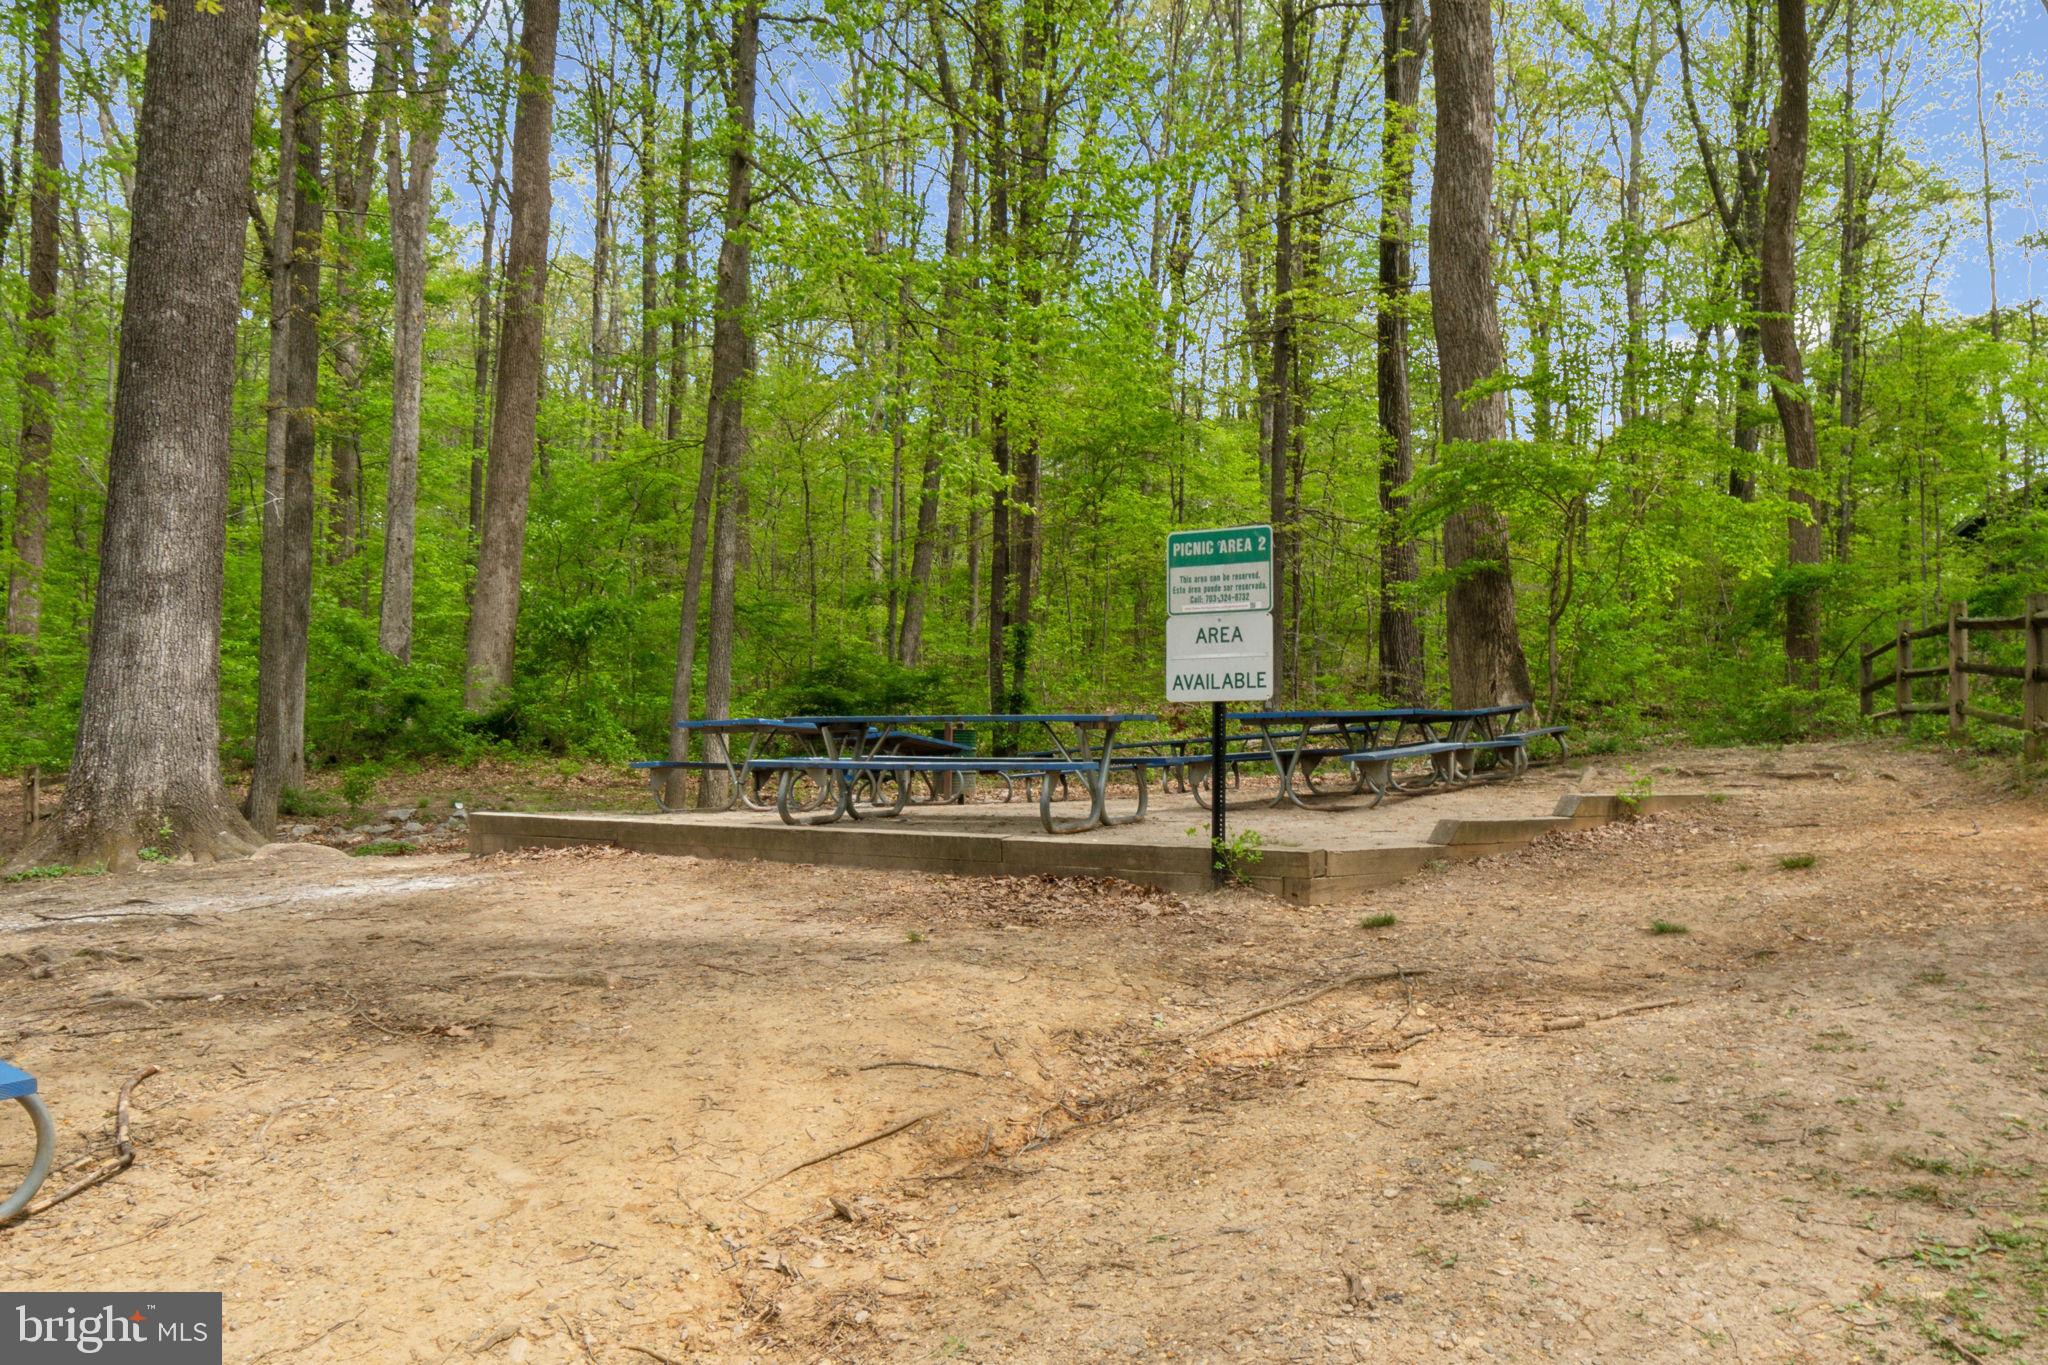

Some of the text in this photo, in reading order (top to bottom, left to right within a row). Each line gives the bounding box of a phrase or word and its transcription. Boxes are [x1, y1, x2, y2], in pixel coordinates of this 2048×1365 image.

[1173, 536, 1266, 556] PICNIC AREA 2
[1180, 575, 1192, 583] This
[1223, 573, 1230, 581] be
[1232, 571, 1260, 580] reserved.
[1204, 584, 1221, 593] puede
[1195, 626, 1243, 644] AREA
[1172, 672, 1267, 690] AVAILABLE
